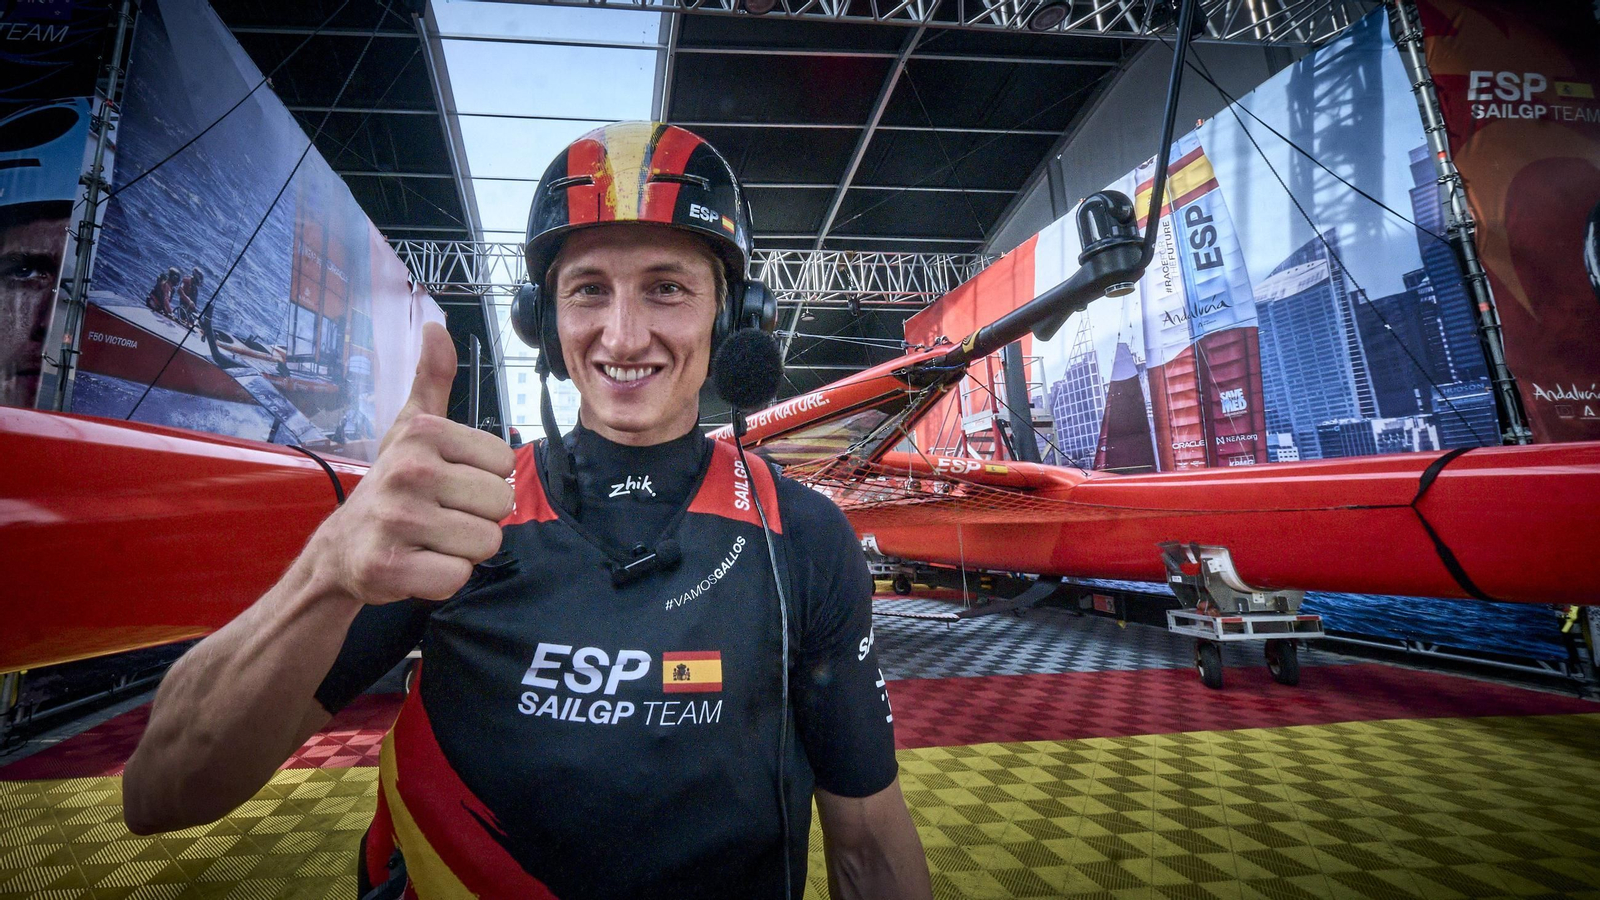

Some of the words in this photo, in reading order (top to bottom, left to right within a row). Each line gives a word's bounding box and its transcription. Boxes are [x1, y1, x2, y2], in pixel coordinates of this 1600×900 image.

[0, 22, 69, 42] TEAM
[1467, 70, 1547, 101] ESP
[1471, 103, 1547, 119] SAILGP
[689, 203, 719, 223] ESP
[1185, 204, 1225, 271] ESP
[1162, 294, 1233, 327] Andalucía
[88, 331, 104, 342] F50
[105, 334, 138, 349] VICTORIA
[1220, 388, 1244, 401] SAVE
[1221, 399, 1247, 413] MED
[760, 410, 776, 427] BY
[1172, 440, 1205, 449] ORACLE
[1226, 434, 1258, 443] NEAR.org
[934, 457, 982, 475] ESP
[1229, 459, 1255, 467] KPMG
[665, 535, 746, 611] #VAMOSGALLOS
[521, 642, 652, 695] ESP
[518, 691, 635, 725] SAILGP
[643, 699, 723, 726] TEAM
